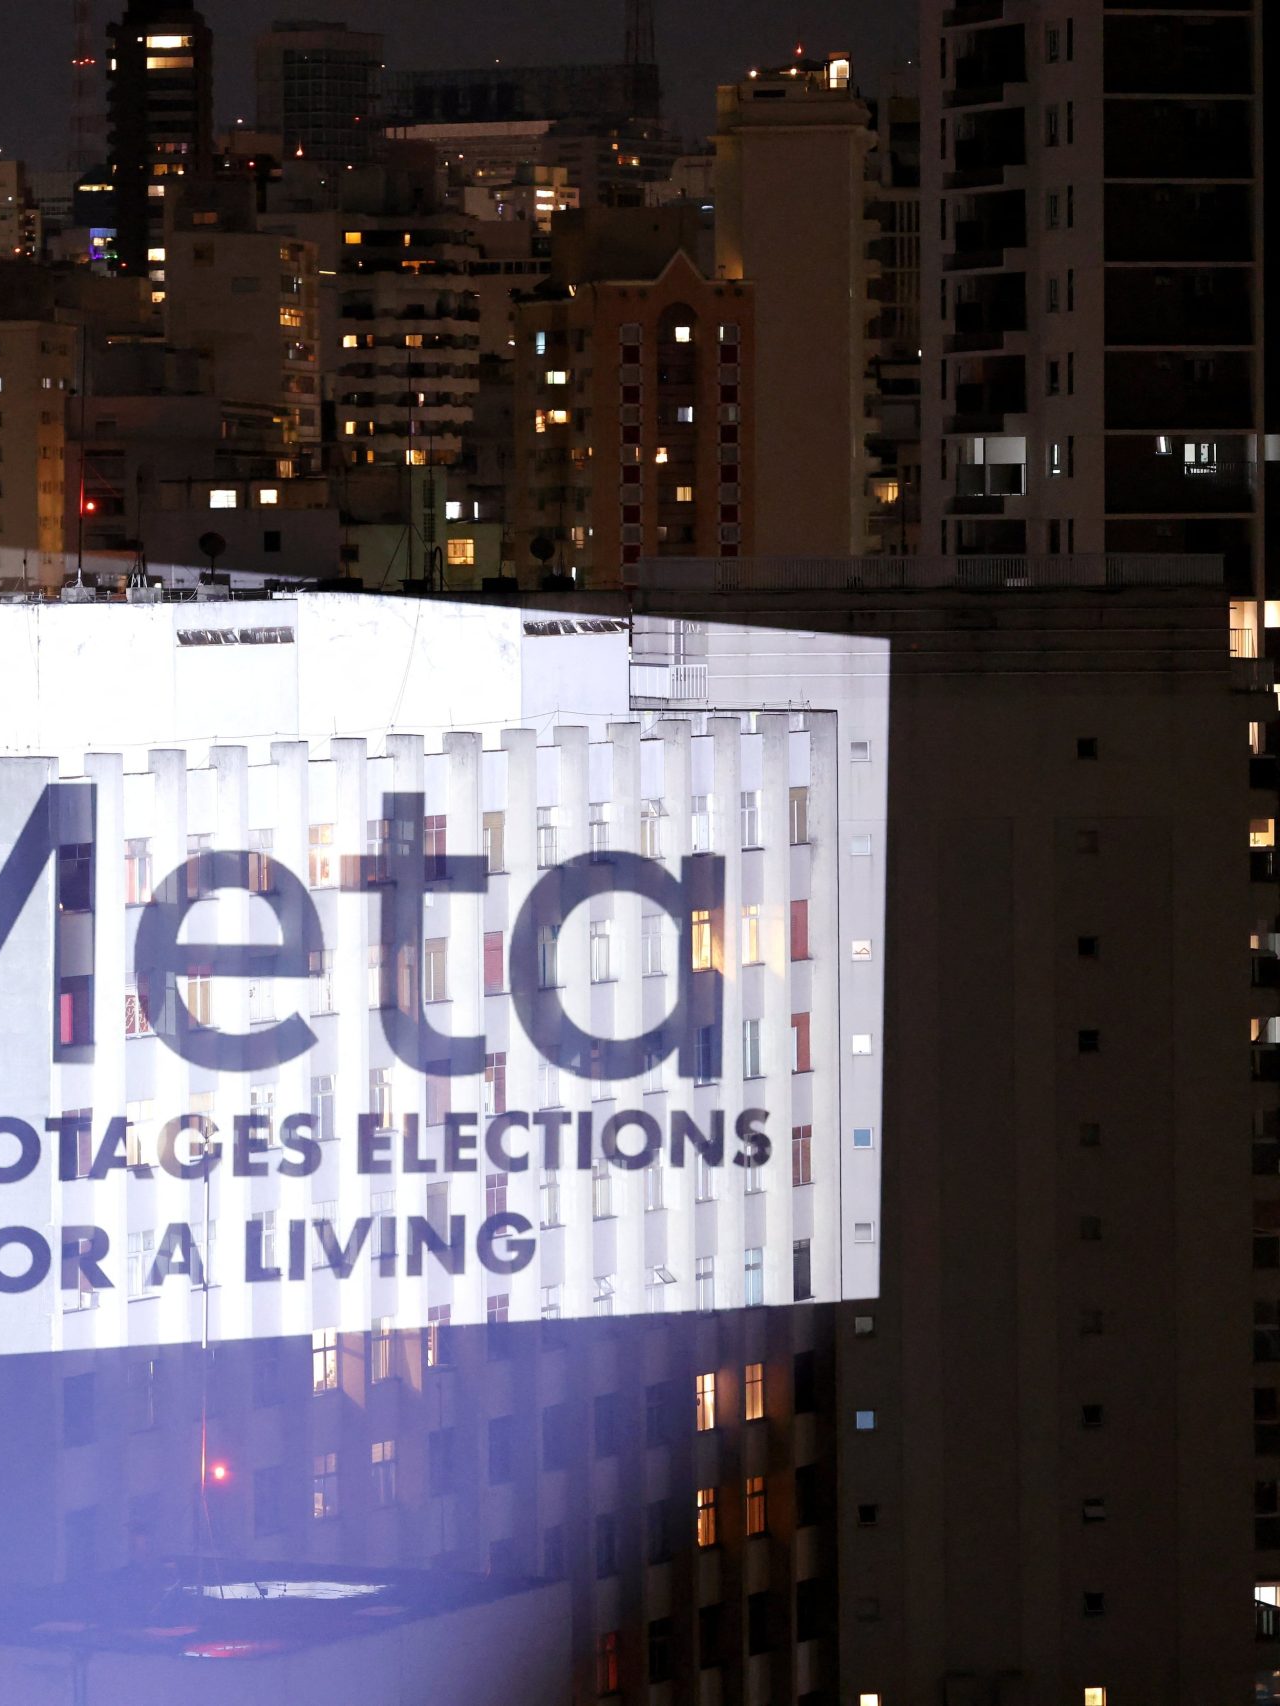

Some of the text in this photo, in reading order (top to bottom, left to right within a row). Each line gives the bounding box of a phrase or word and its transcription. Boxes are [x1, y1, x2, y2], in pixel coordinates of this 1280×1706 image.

[356, 1107, 772, 1175] ELECTIONS
[144, 1221, 204, 1286] A
[245, 1211, 537, 1284] LIVING
